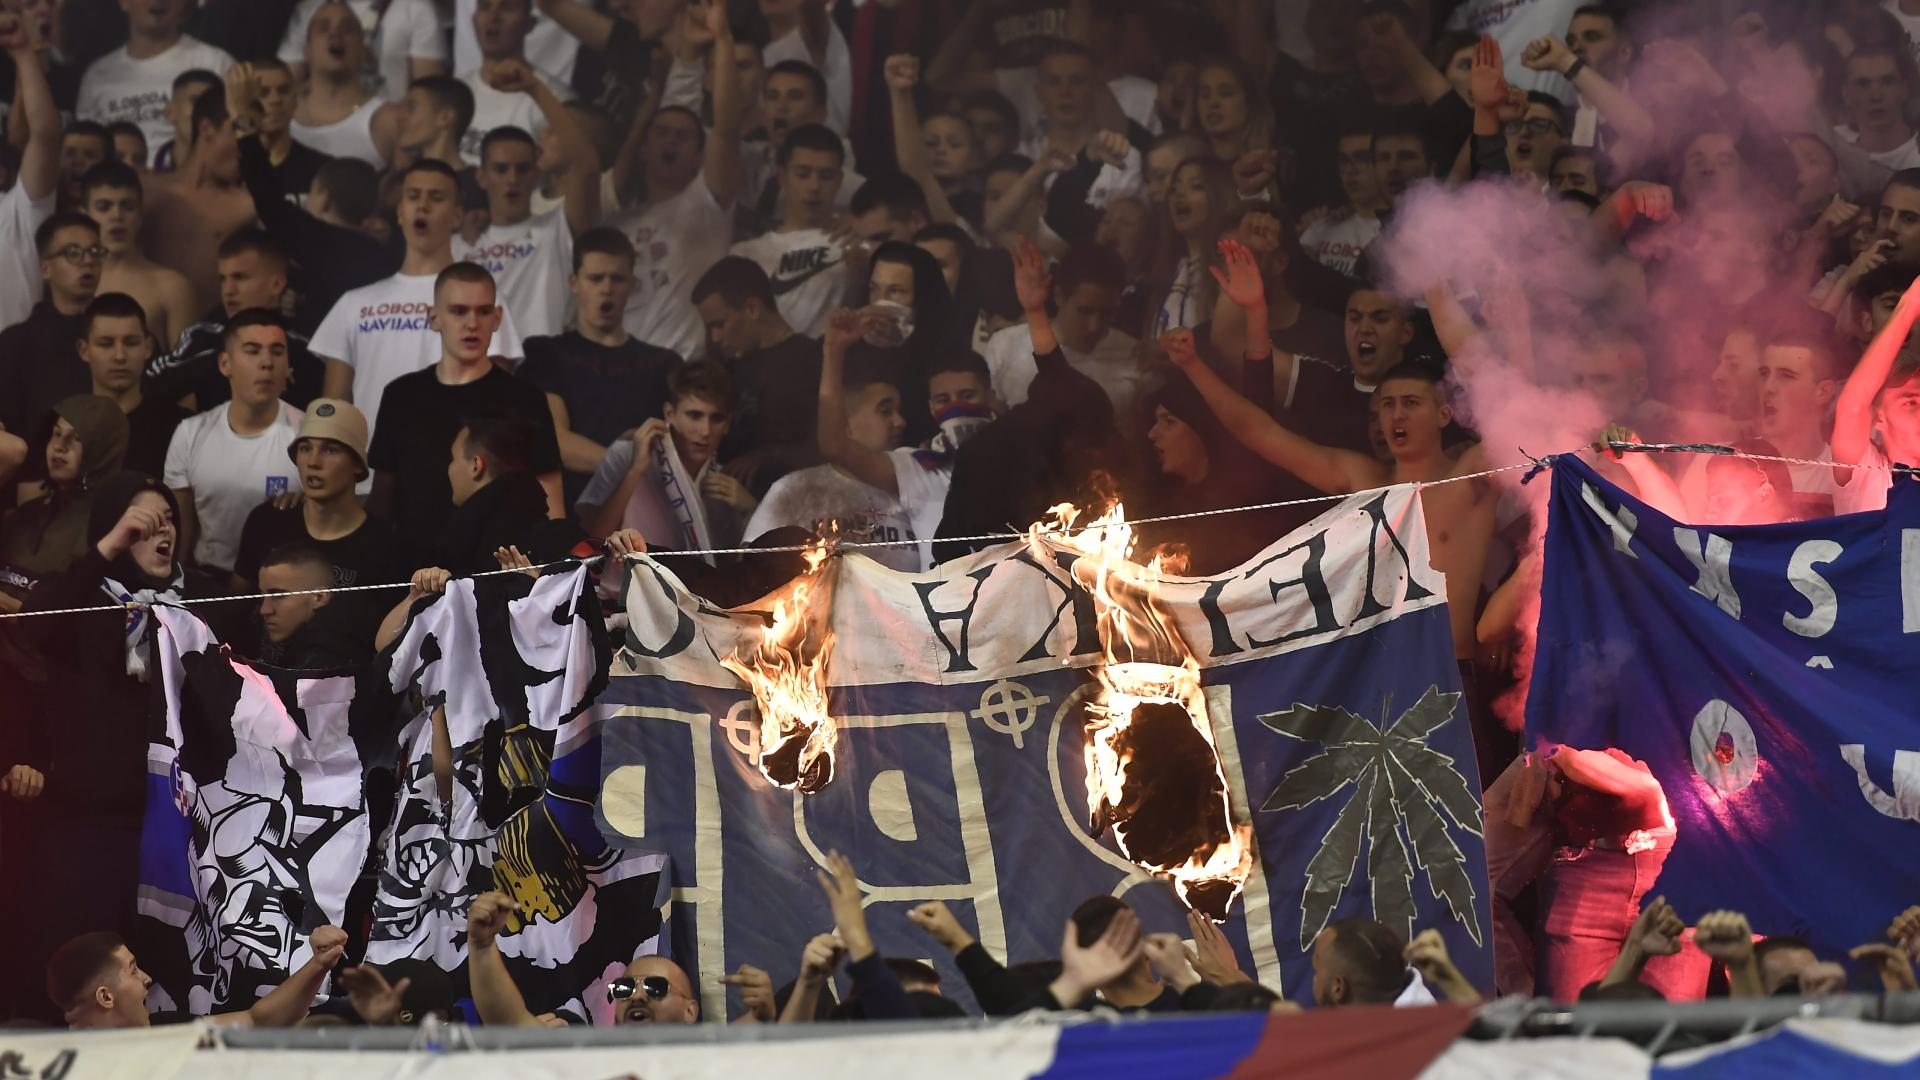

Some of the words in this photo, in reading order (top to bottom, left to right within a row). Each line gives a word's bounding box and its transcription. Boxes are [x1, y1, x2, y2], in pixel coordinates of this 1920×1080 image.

[779, 245, 830, 276] NIKE
[360, 302, 429, 319] SLOBOD
[912, 490, 1434, 674] VELKA
